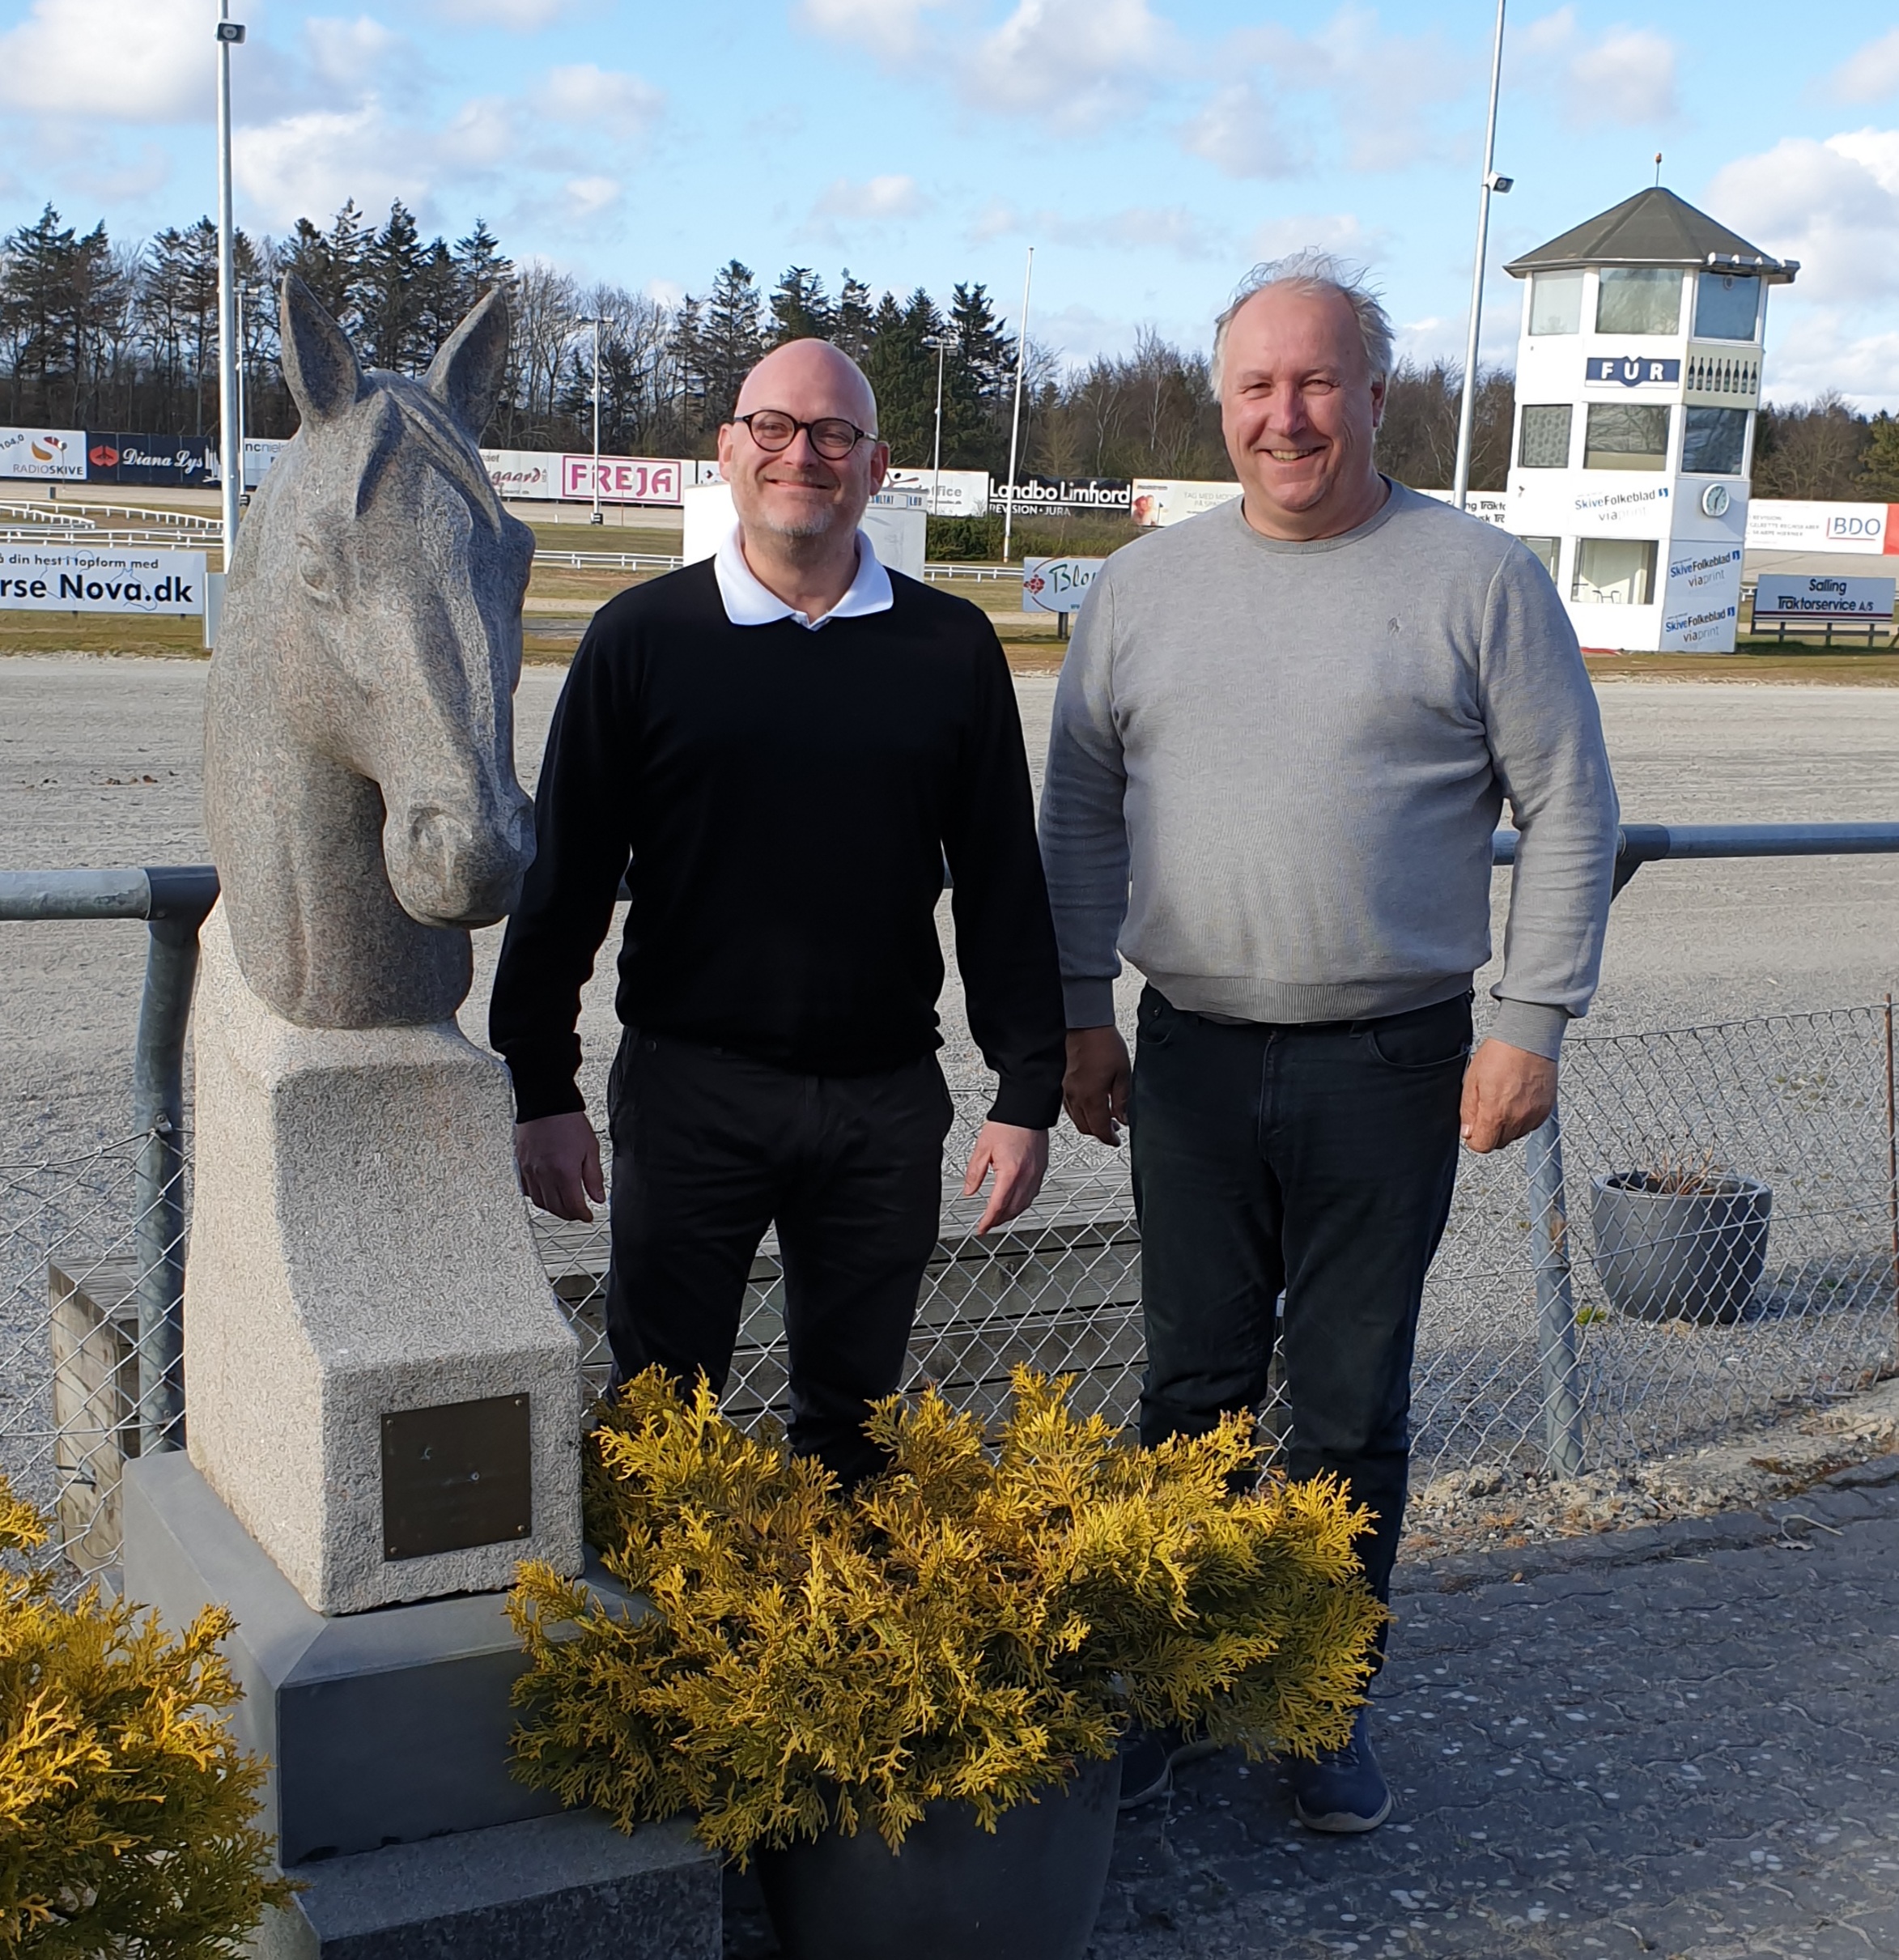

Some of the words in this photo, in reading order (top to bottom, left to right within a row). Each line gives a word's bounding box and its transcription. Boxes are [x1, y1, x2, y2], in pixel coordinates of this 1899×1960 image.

[123, 448, 172, 466] Diana
[174, 450, 202, 474] Lys
[487, 467, 541, 486] gaard
[571, 464, 672, 497] FREJA
[990, 478, 1058, 500] Landbo
[1060, 481, 1131, 505] Limfjord
[1044, 506, 1071, 516] JURA
[1834, 517, 1880, 536] BDO
[9, 554, 30, 564] din
[35, 555, 62, 566] hest
[66, 556, 70, 566] i
[74, 556, 126, 569] topform
[131, 559, 159, 569] med
[60, 574, 193, 602] Nova.dk
[1809, 578, 1847, 596] Salling
[1778, 596, 1857, 610] Traktorservice
